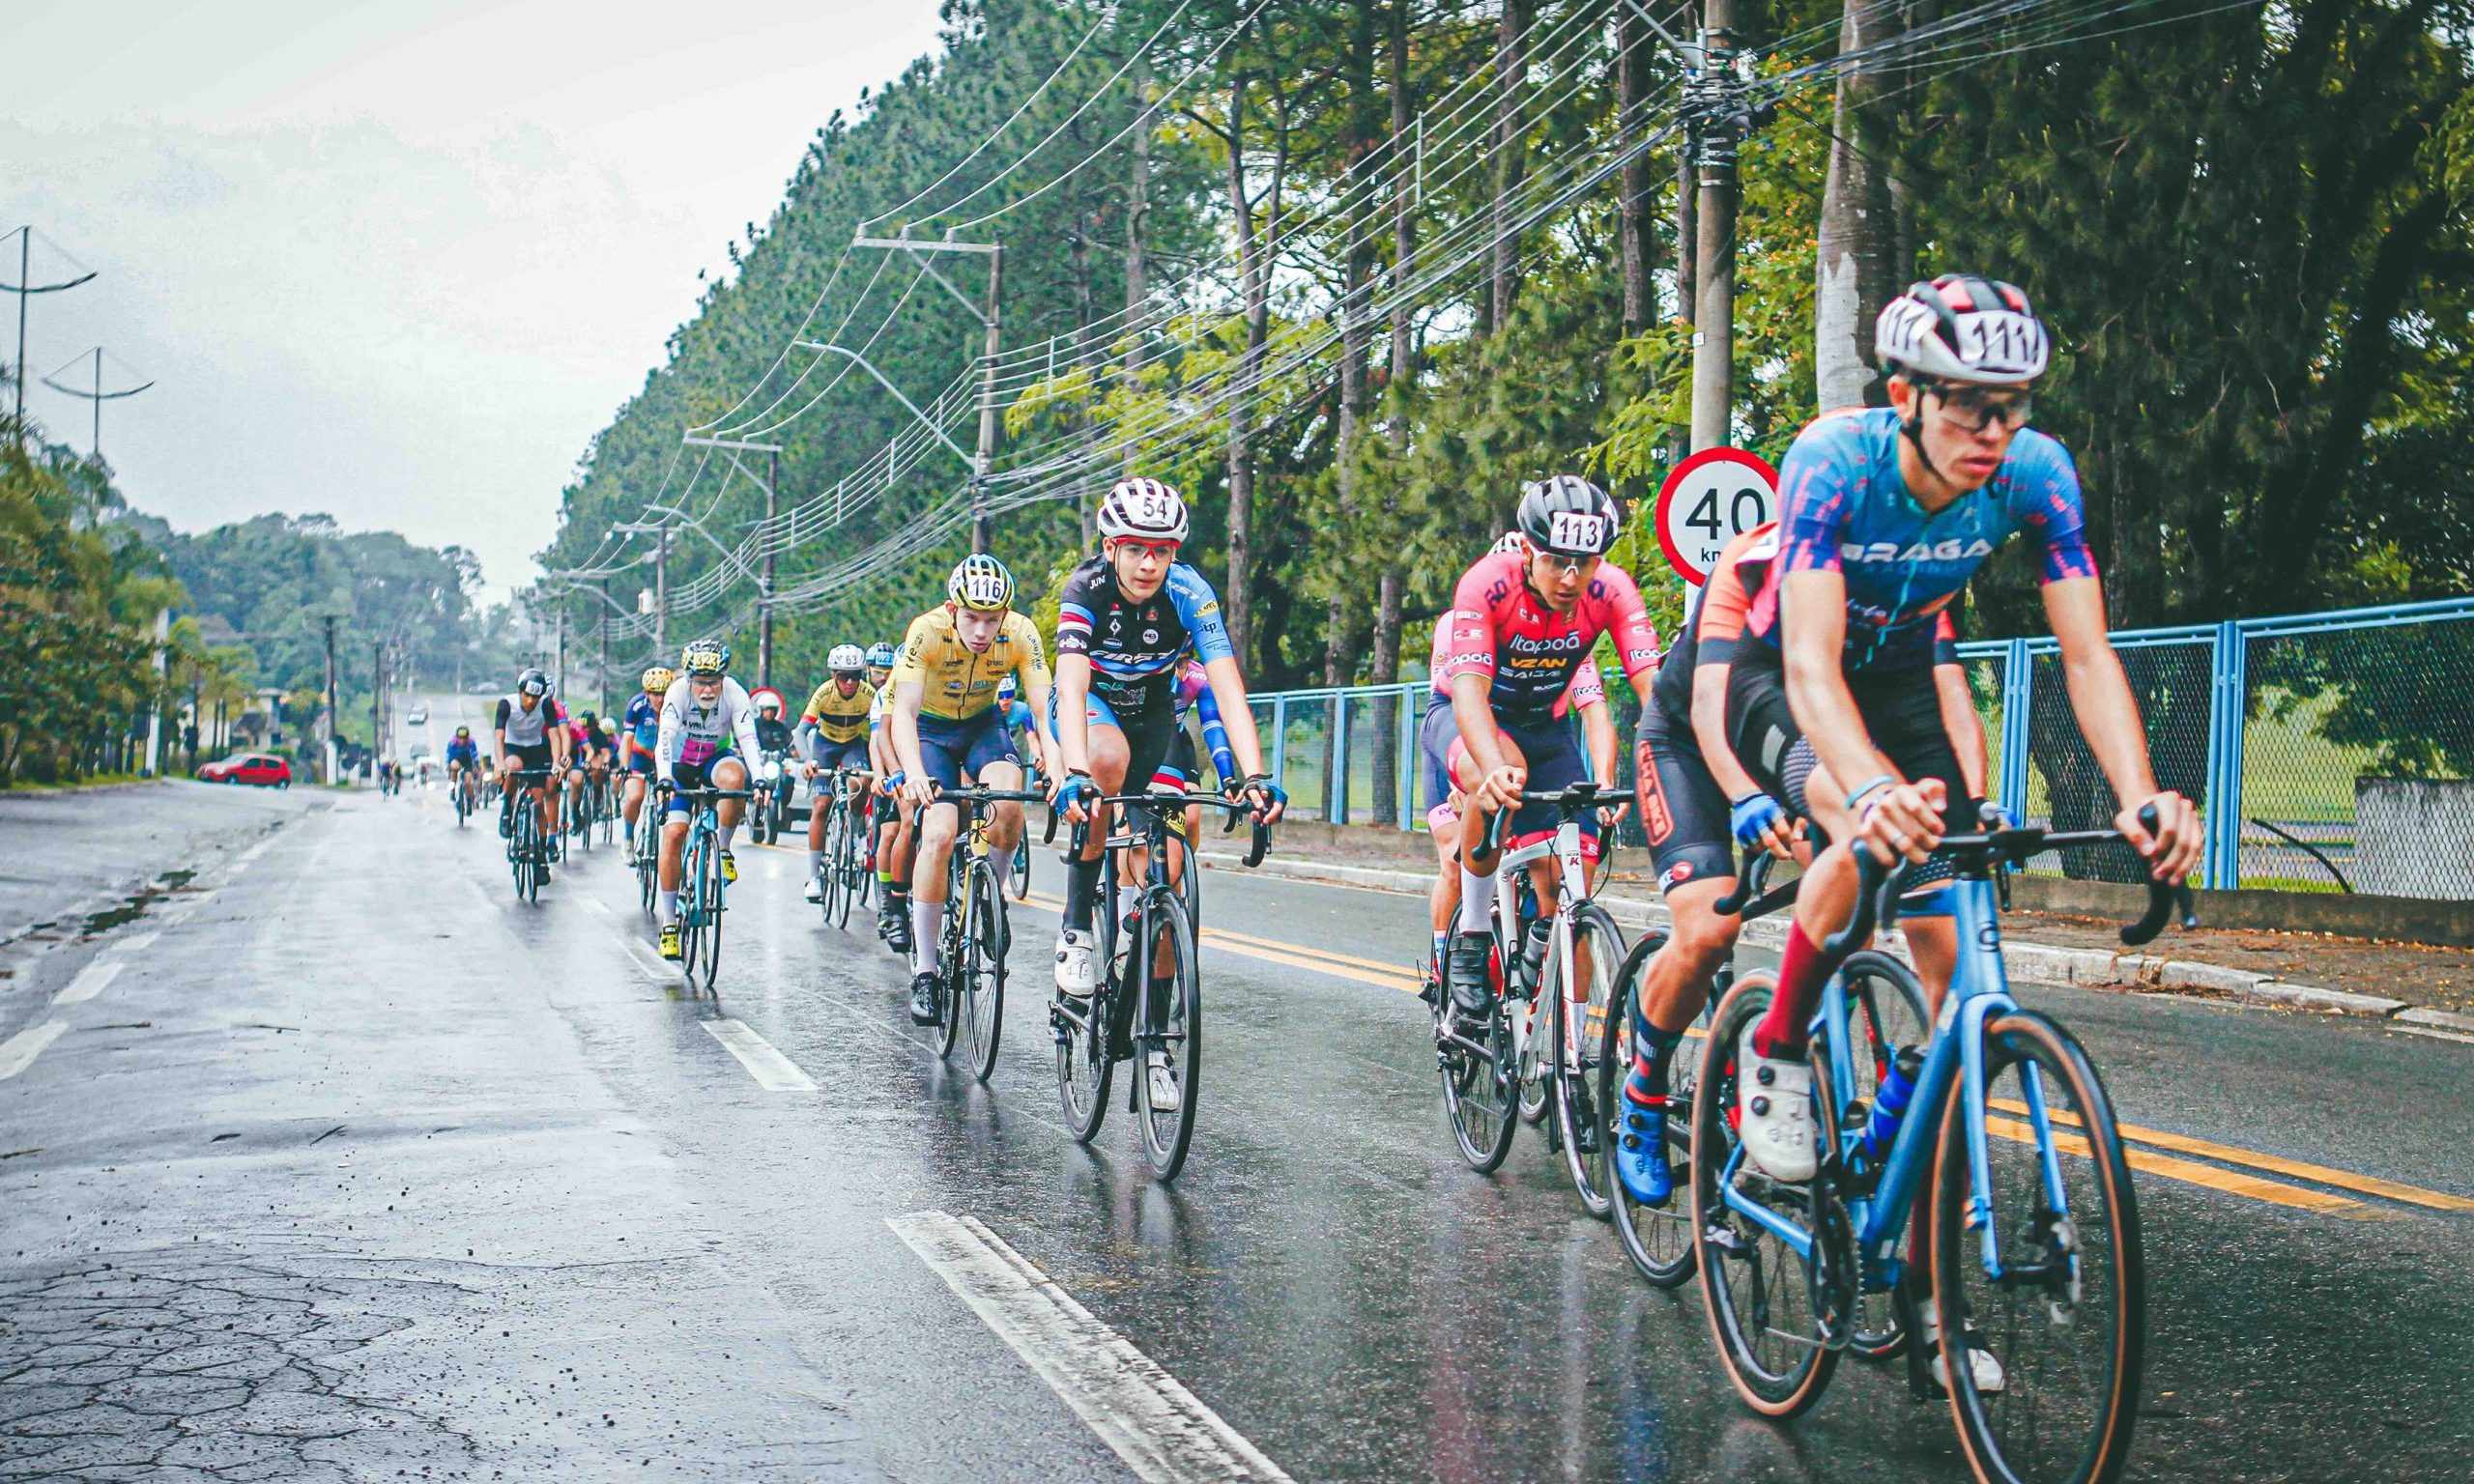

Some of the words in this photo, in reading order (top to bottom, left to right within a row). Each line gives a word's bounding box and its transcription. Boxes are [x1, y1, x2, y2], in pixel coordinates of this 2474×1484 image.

[1143, 497, 1167, 520] 54
[1684, 487, 1767, 540] 40
[1559, 517, 1598, 548] 113
[973, 578, 1002, 599] 116
